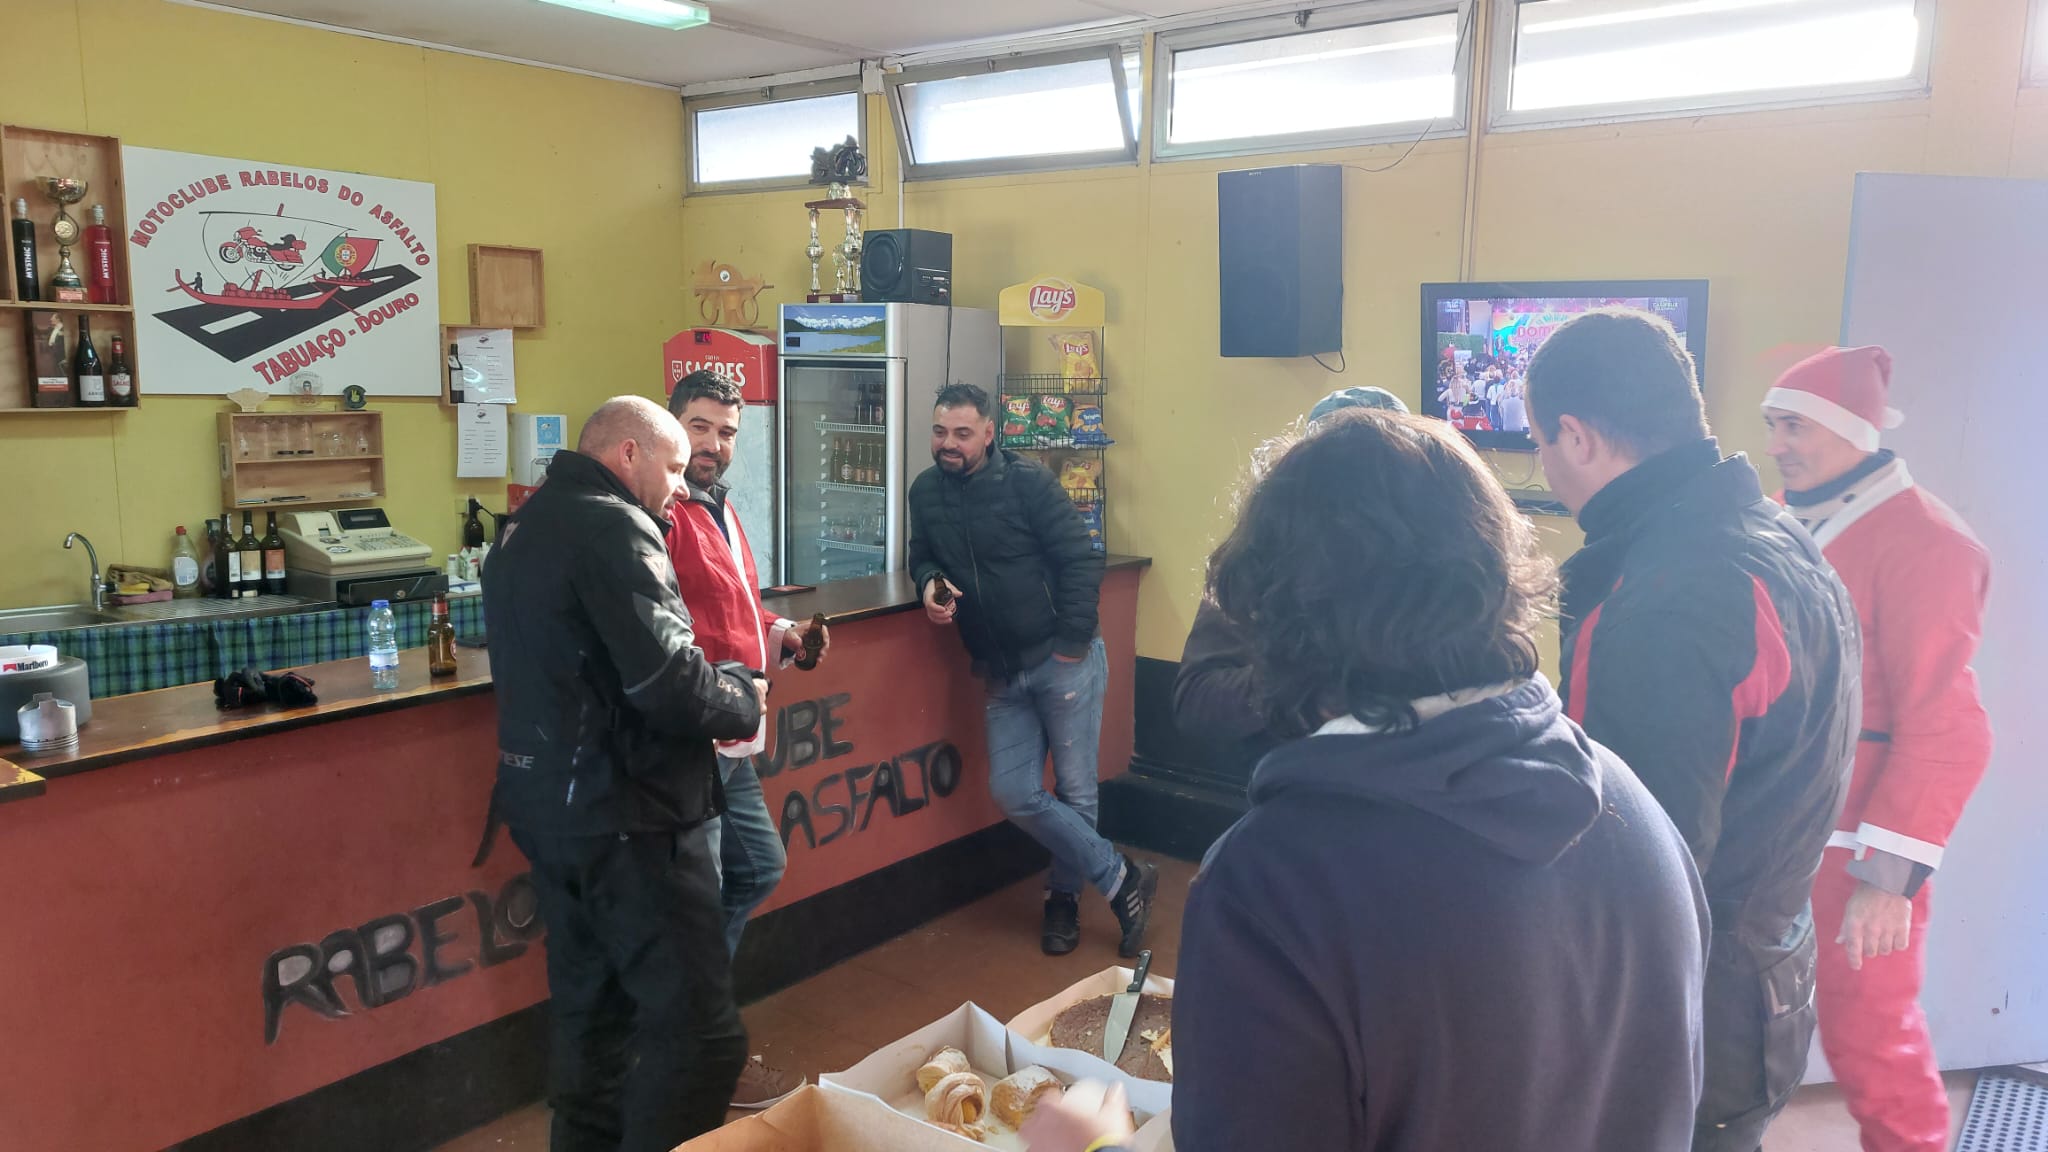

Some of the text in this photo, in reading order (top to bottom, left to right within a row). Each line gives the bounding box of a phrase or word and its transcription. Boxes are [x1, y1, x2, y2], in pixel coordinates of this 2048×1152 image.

[130, 170, 430, 266] MOTOCLUBE RABELOS DO ASFALTO
[252, 328, 347, 386] TABUAÇO
[355, 292, 420, 334] DOURO
[1033, 286, 1073, 313] Lay's
[17, 659, 49, 672] Marlboro
[780, 737, 962, 849] ASFALTO
